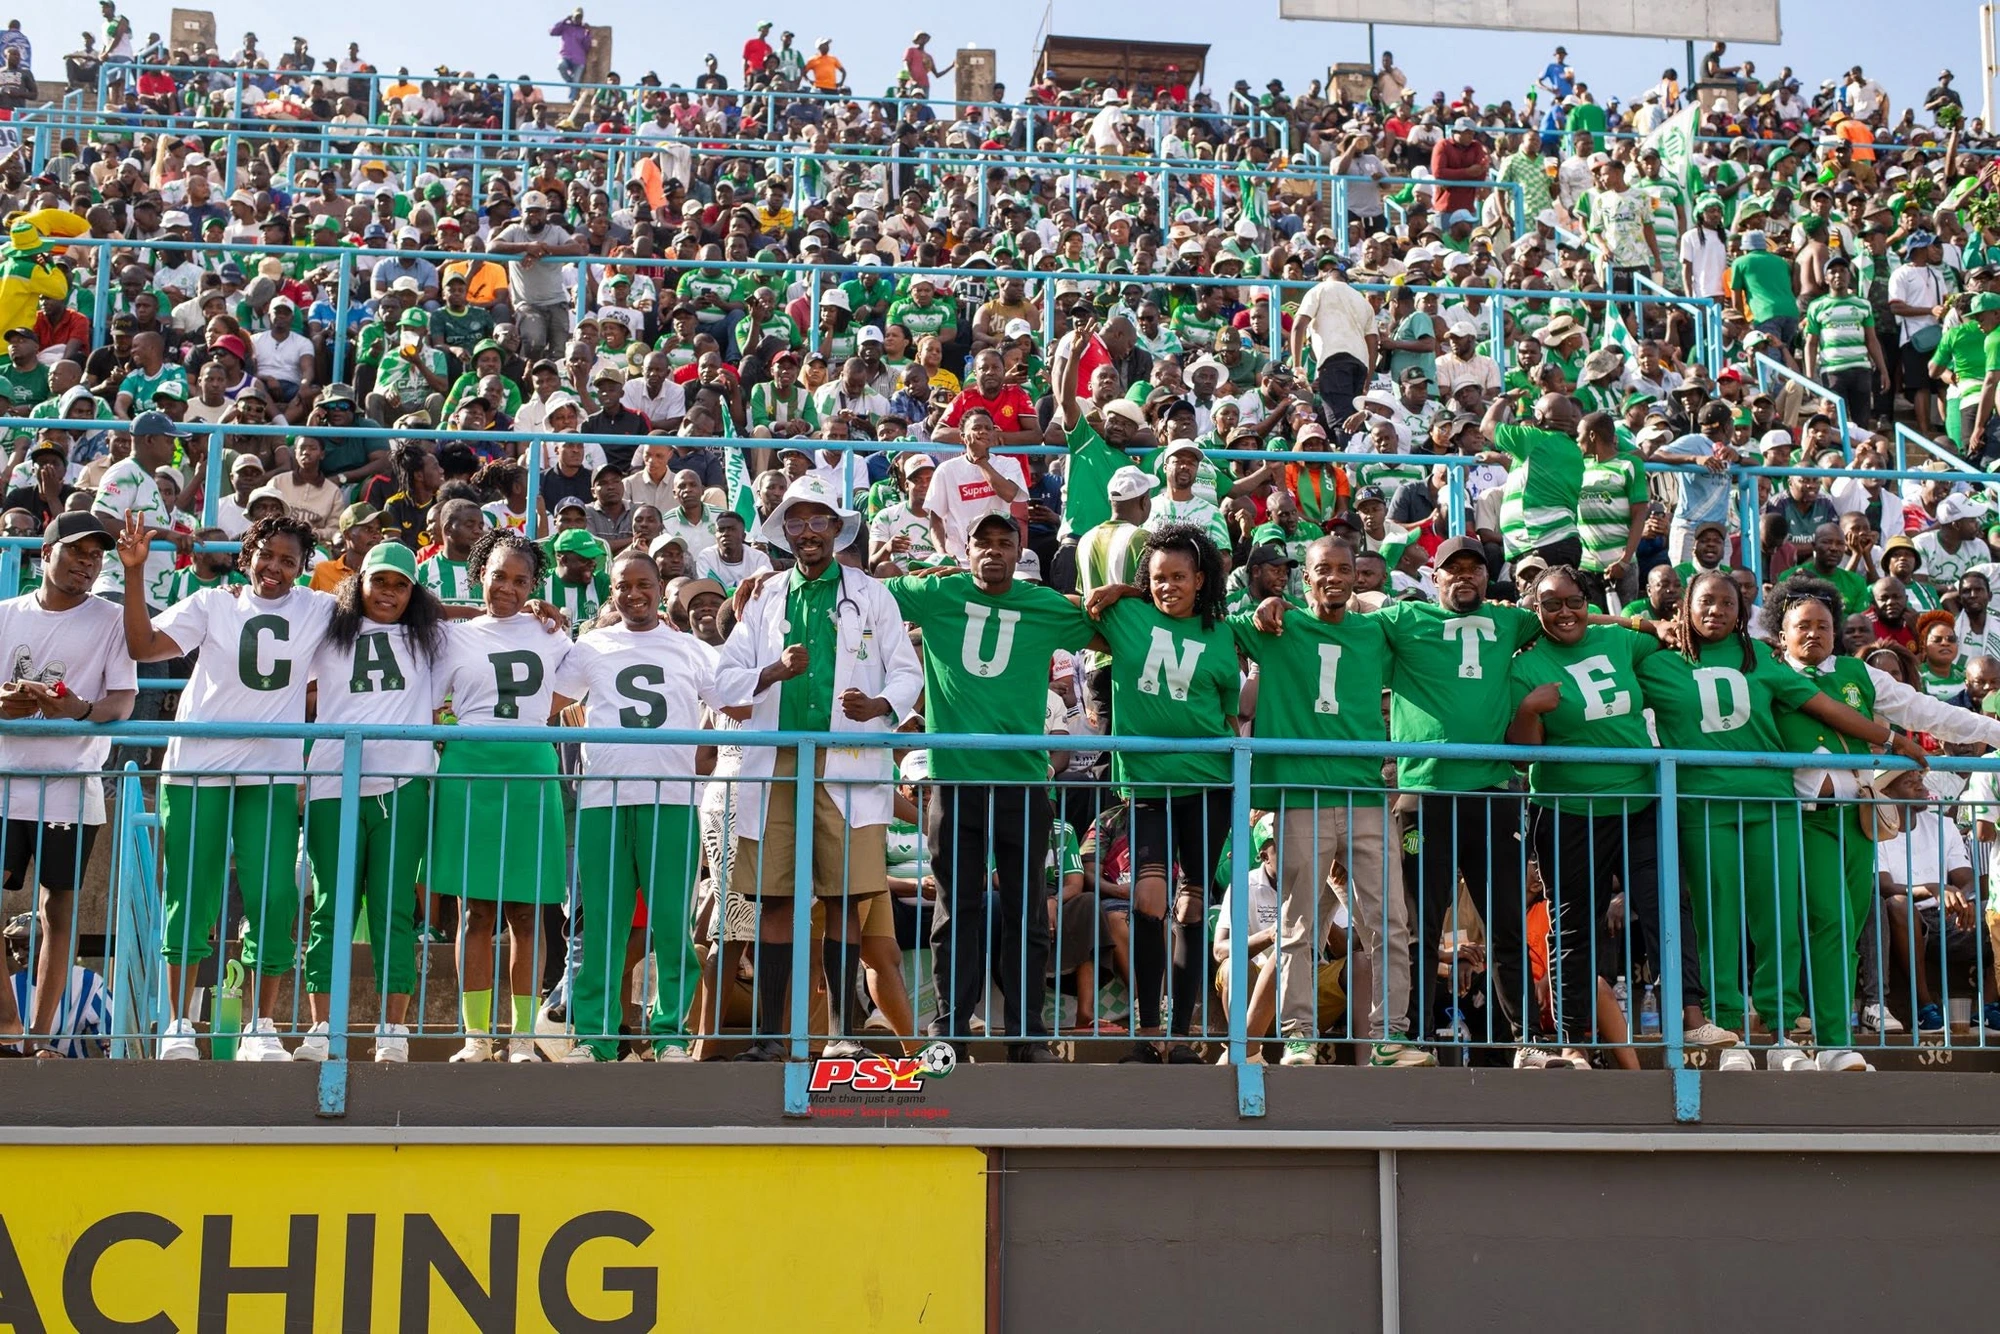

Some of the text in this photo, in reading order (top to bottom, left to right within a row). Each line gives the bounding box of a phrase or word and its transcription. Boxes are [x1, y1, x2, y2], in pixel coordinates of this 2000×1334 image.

[961, 484, 994, 498] Suprem
[239, 614, 291, 692] C
[350, 632, 406, 693] A
[962, 601, 1021, 678] U
[1137, 625, 1206, 701] N
[1443, 616, 1498, 680] T
[487, 650, 544, 719] P
[615, 664, 667, 729] S
[1314, 643, 1342, 715] I
[1565, 654, 1632, 722] E
[1693, 667, 1751, 733] D
